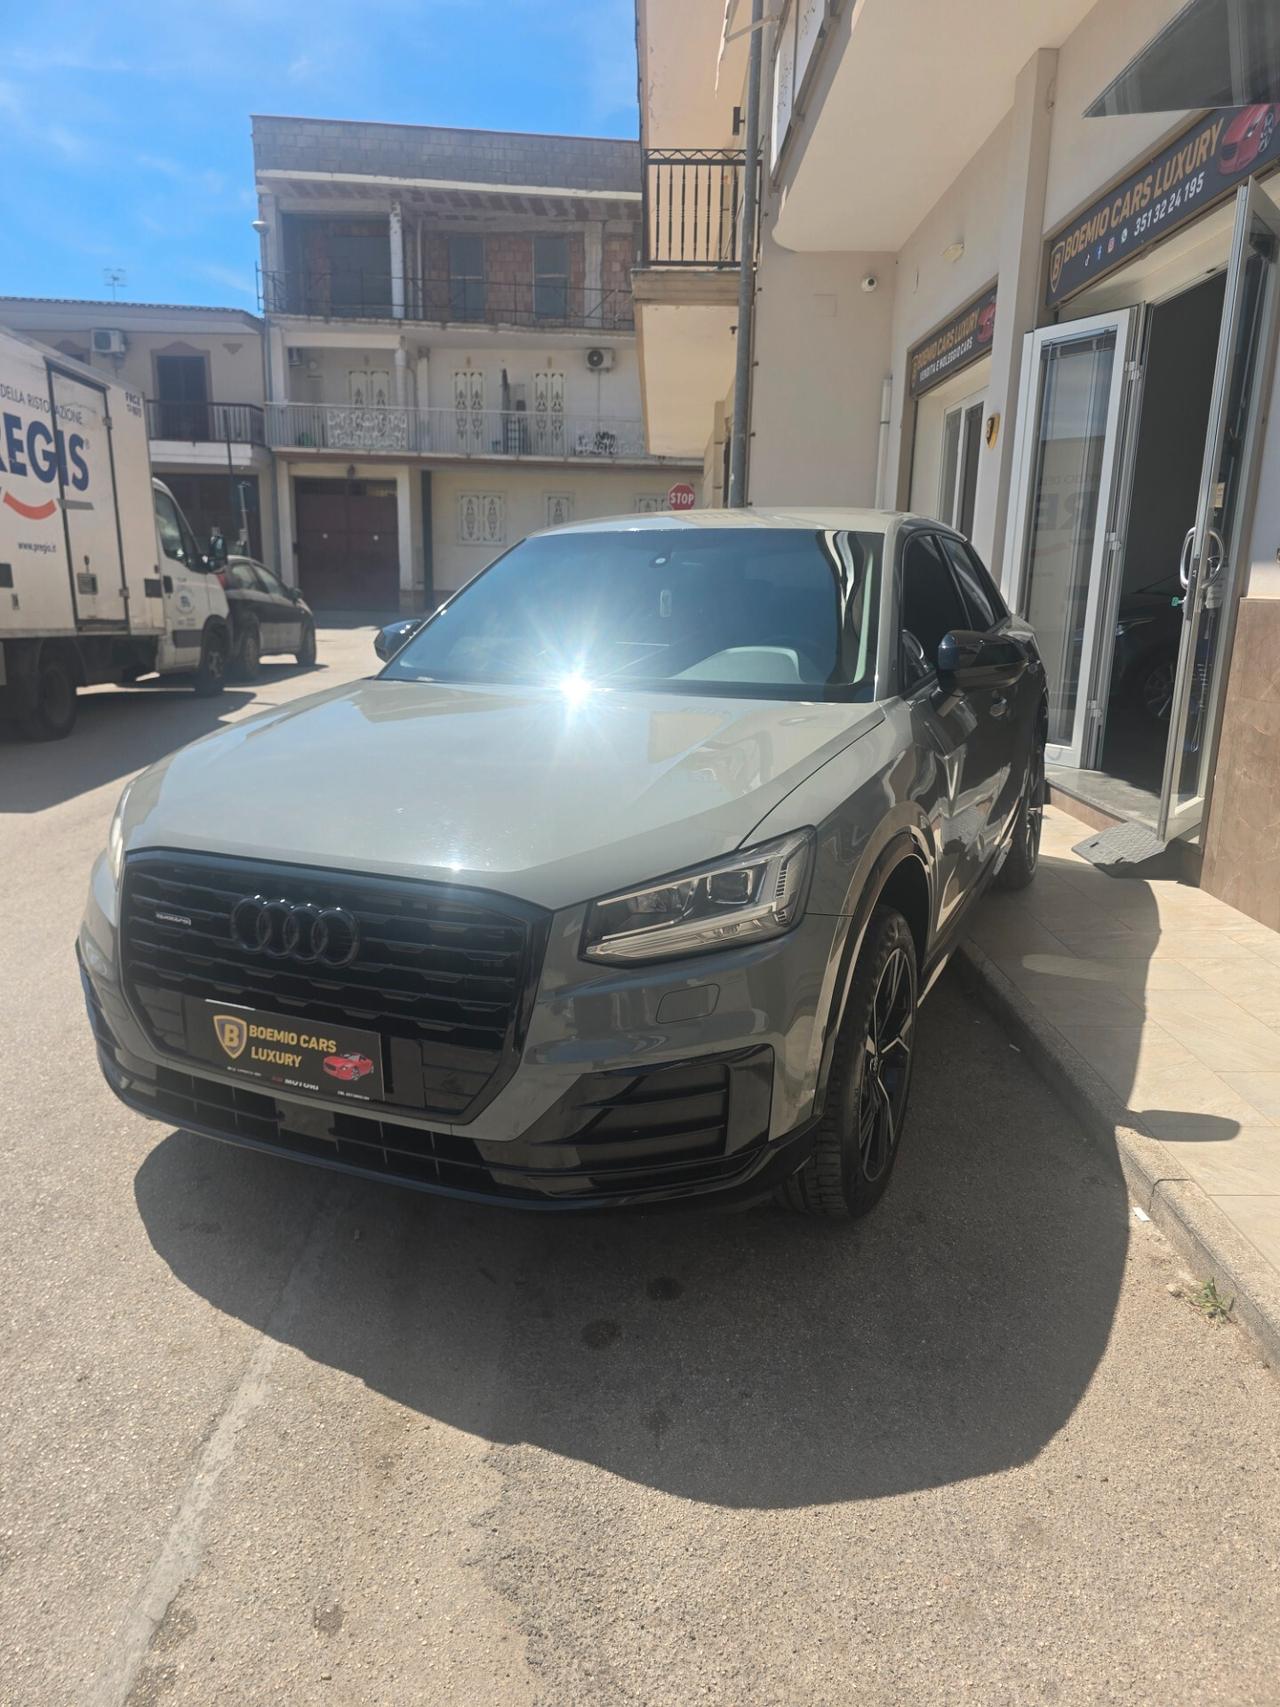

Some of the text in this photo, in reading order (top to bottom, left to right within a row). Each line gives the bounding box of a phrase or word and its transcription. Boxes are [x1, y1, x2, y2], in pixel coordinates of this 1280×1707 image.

[1064, 117, 1225, 263] BOEMIO CARS LUXURY
[1133, 172, 1205, 237] 351 32 24 195
[26, 393, 83, 425] RISTOAZIONE
[0, 411, 89, 492] EGIS
[670, 492, 694, 505] STOP
[223, 1023, 240, 1047] B
[249, 1024, 337, 1054] BOEMIO CARS
[251, 1046, 302, 1068] LUXURY
